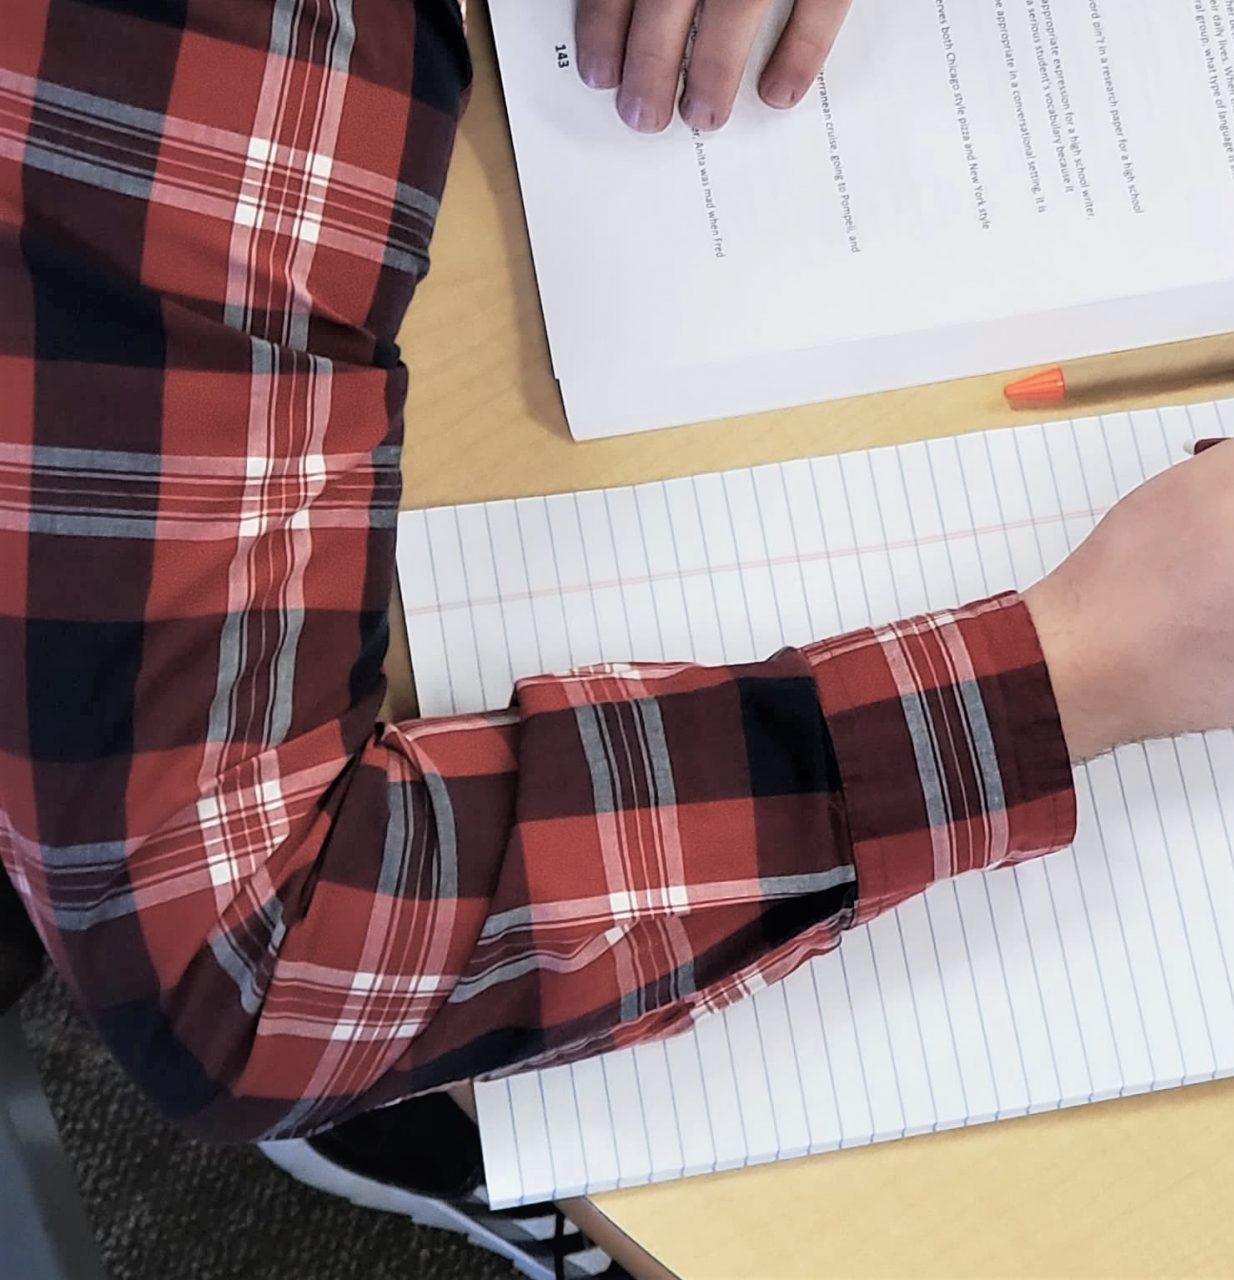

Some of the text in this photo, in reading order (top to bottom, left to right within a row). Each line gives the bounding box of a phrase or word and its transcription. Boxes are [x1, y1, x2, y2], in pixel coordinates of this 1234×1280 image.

[940, 25, 954, 50] both
[555, 44, 570, 69] 143
[945, 51, 960, 91] Chicago
[953, 91, 966, 115] style
[824, 121, 838, 153] cruise,
[956, 116, 970, 141] pizza
[693, 141, 706, 166] Anita
[963, 142, 977, 161] and
[699, 167, 709, 187] was
[829, 154, 844, 181] going
[967, 161, 979, 184] New
[703, 187, 716, 209] mad
[837, 181, 846, 193] to
[973, 184, 986, 207] York
[707, 209, 719, 236] when
[840, 193, 855, 233] Pompeii,
[977, 207, 991, 229] style
[713, 237, 726, 258] Fred
[848, 235, 861, 253] and
